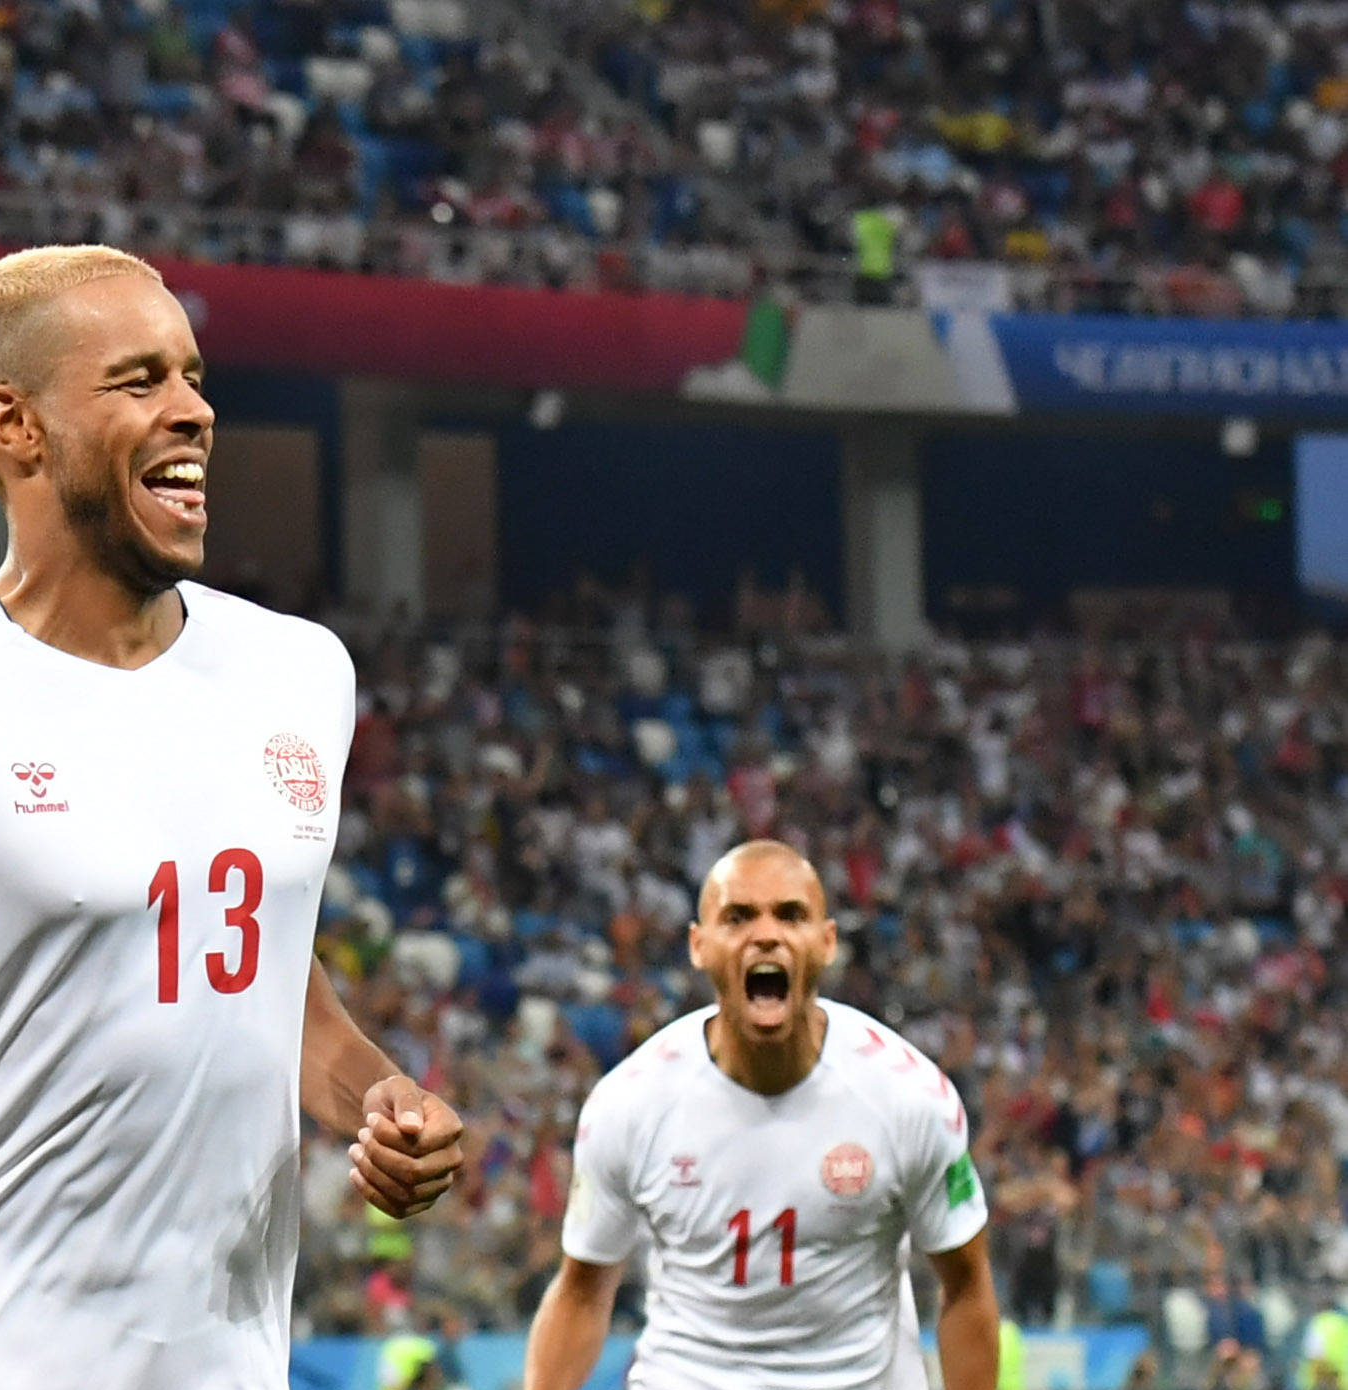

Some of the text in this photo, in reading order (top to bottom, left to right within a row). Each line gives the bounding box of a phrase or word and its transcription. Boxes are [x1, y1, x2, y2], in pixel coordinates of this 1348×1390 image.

[14, 800, 70, 814] hummel
[148, 847, 264, 1004] 13
[727, 1208, 797, 1287] 11
